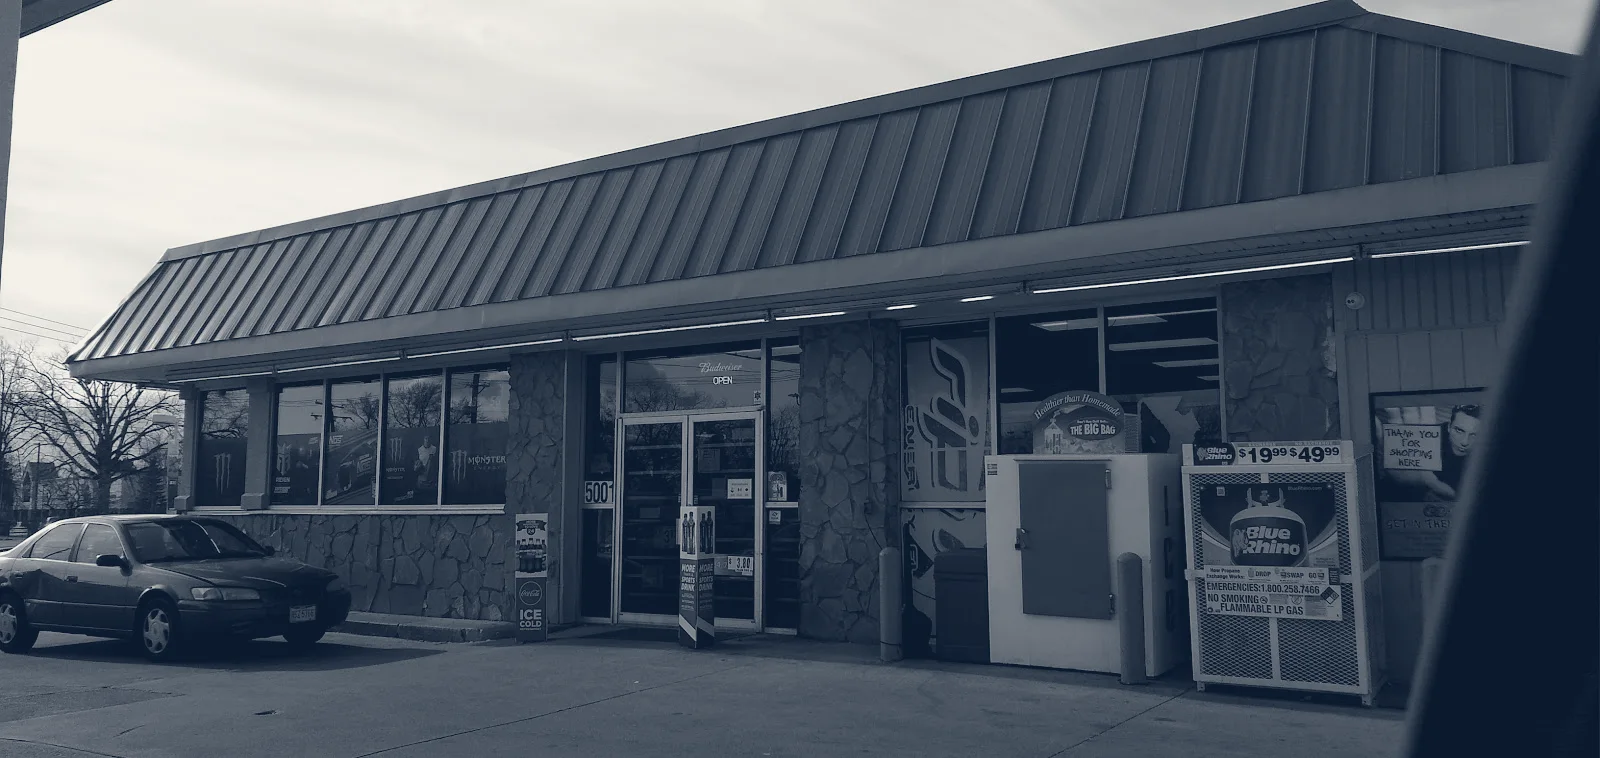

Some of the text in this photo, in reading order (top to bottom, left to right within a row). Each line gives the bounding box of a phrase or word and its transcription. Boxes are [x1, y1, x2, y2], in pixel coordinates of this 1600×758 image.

[698, 362, 743, 373] Budweiser
[712, 376, 733, 385] OPEN
[1034, 393, 1121, 420] Healthier than Homemade
[1070, 423, 1116, 435] THE BIG BAG
[1384, 428, 1439, 439] THANK YOU
[1401, 438, 1421, 448] FOR
[1205, 453, 1233, 461] Rhino
[1389, 448, 1433, 459] SHOPPING
[468, 455, 507, 465] MONSTER
[1398, 459, 1421, 468] HERE
[585, 481, 614, 503] 5001
[1246, 525, 1291, 540] Blue
[1242, 540, 1300, 556] Rhino
[681, 563, 696, 573] MORE
[699, 563, 714, 573] MORE
[736, 557, 751, 569] 3.80
[681, 576, 696, 584] SPORTS
[681, 583, 696, 592] DRINK
[1207, 593, 1259, 604] NO SMOKING
[519, 609, 542, 620] ICE
[1220, 603, 1304, 615] FLAMMABLE LP GAS
[519, 620, 542, 628] COLD
